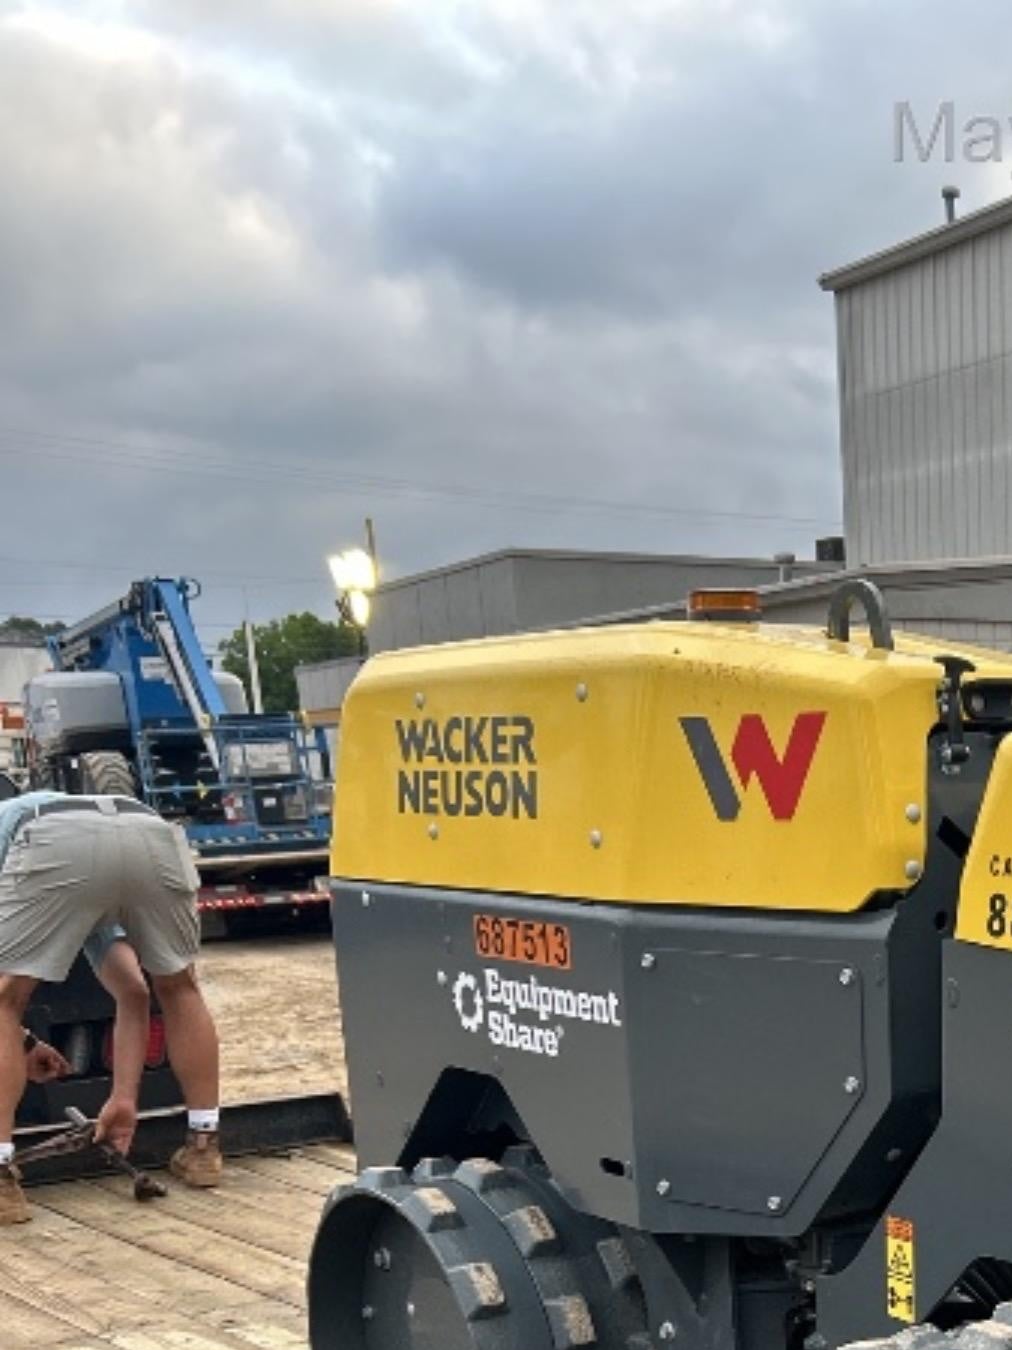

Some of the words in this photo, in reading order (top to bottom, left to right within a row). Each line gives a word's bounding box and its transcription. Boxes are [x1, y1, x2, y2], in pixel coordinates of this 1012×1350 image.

[395, 715, 538, 765] WACKER
[397, 769, 538, 820] NEUSON
[475, 916, 569, 967] 687513
[484, 967, 622, 1027] Equipment
